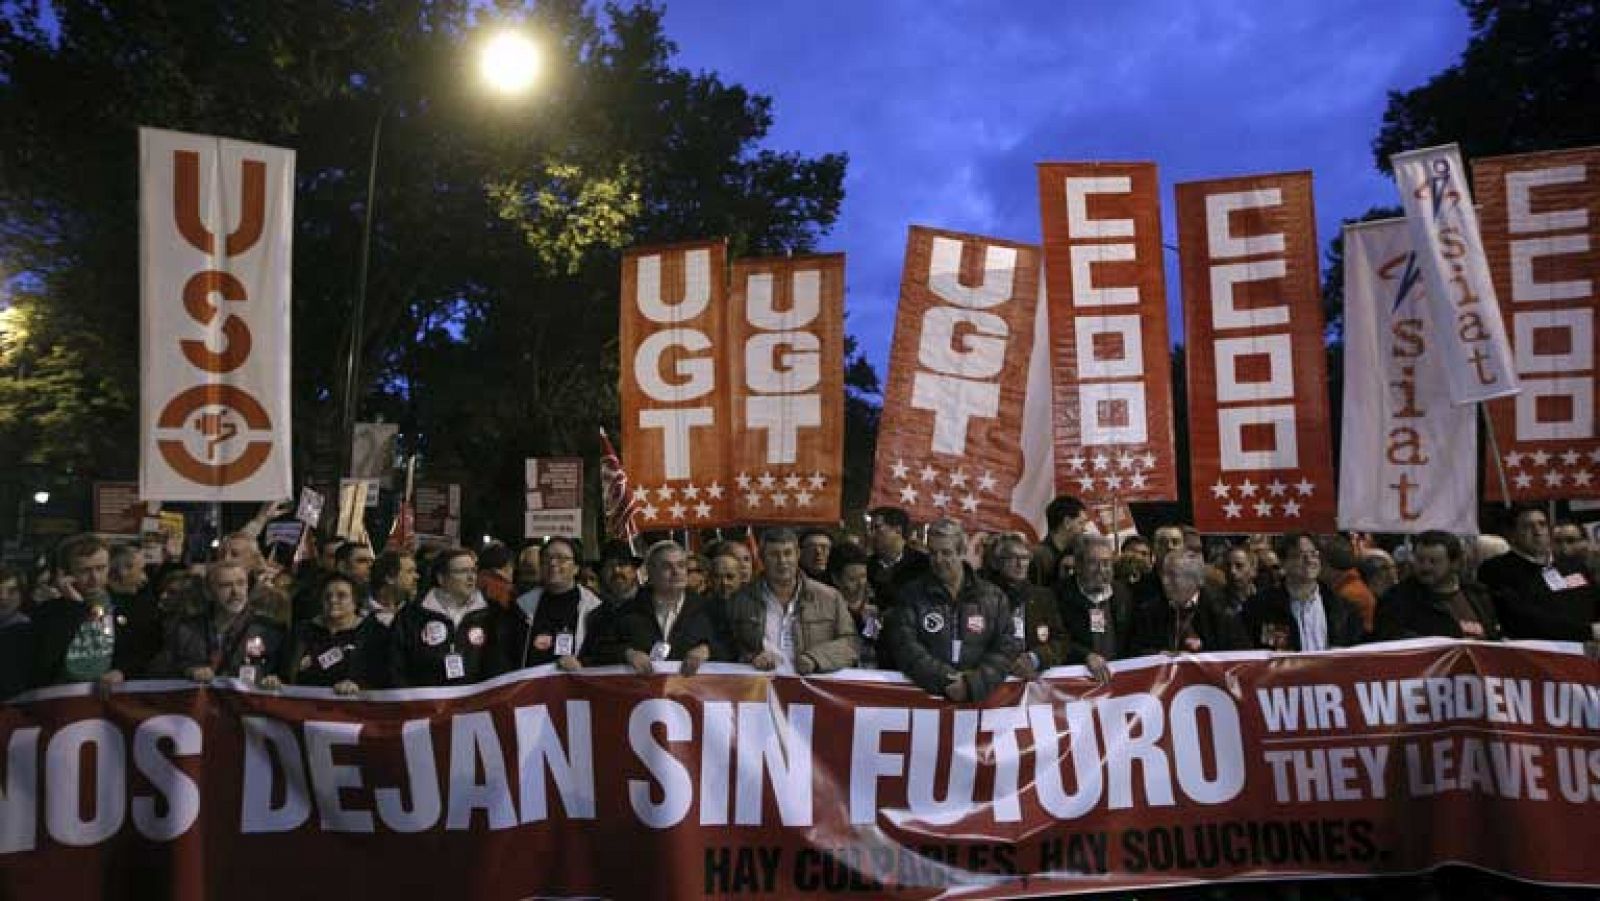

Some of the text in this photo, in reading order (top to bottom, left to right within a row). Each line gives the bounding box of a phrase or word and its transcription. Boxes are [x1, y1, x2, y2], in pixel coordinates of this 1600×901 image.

[157, 149, 273, 487] USO
[634, 248, 716, 480] UGT
[745, 268, 821, 464] UGT
[911, 236, 1018, 456] UGT
[1066, 176, 1150, 446] CCOO
[1205, 188, 1299, 471] CCOO
[1438, 225, 1497, 386] siat
[1505, 164, 1595, 442] CCOO
[1386, 318, 1430, 521] siat
[240, 700, 598, 835] DEJAN
[627, 698, 813, 830] SIN
[850, 684, 1247, 827] FUTURO
[1257, 674, 1600, 732] WIR WERDEN UN
[1265, 745, 1390, 804] THEY
[1406, 736, 1549, 801] LEAVE
[704, 847, 782, 894] HAY
[1040, 831, 1108, 874] HAY
[1121, 819, 1393, 871] SOLUCIONES.
